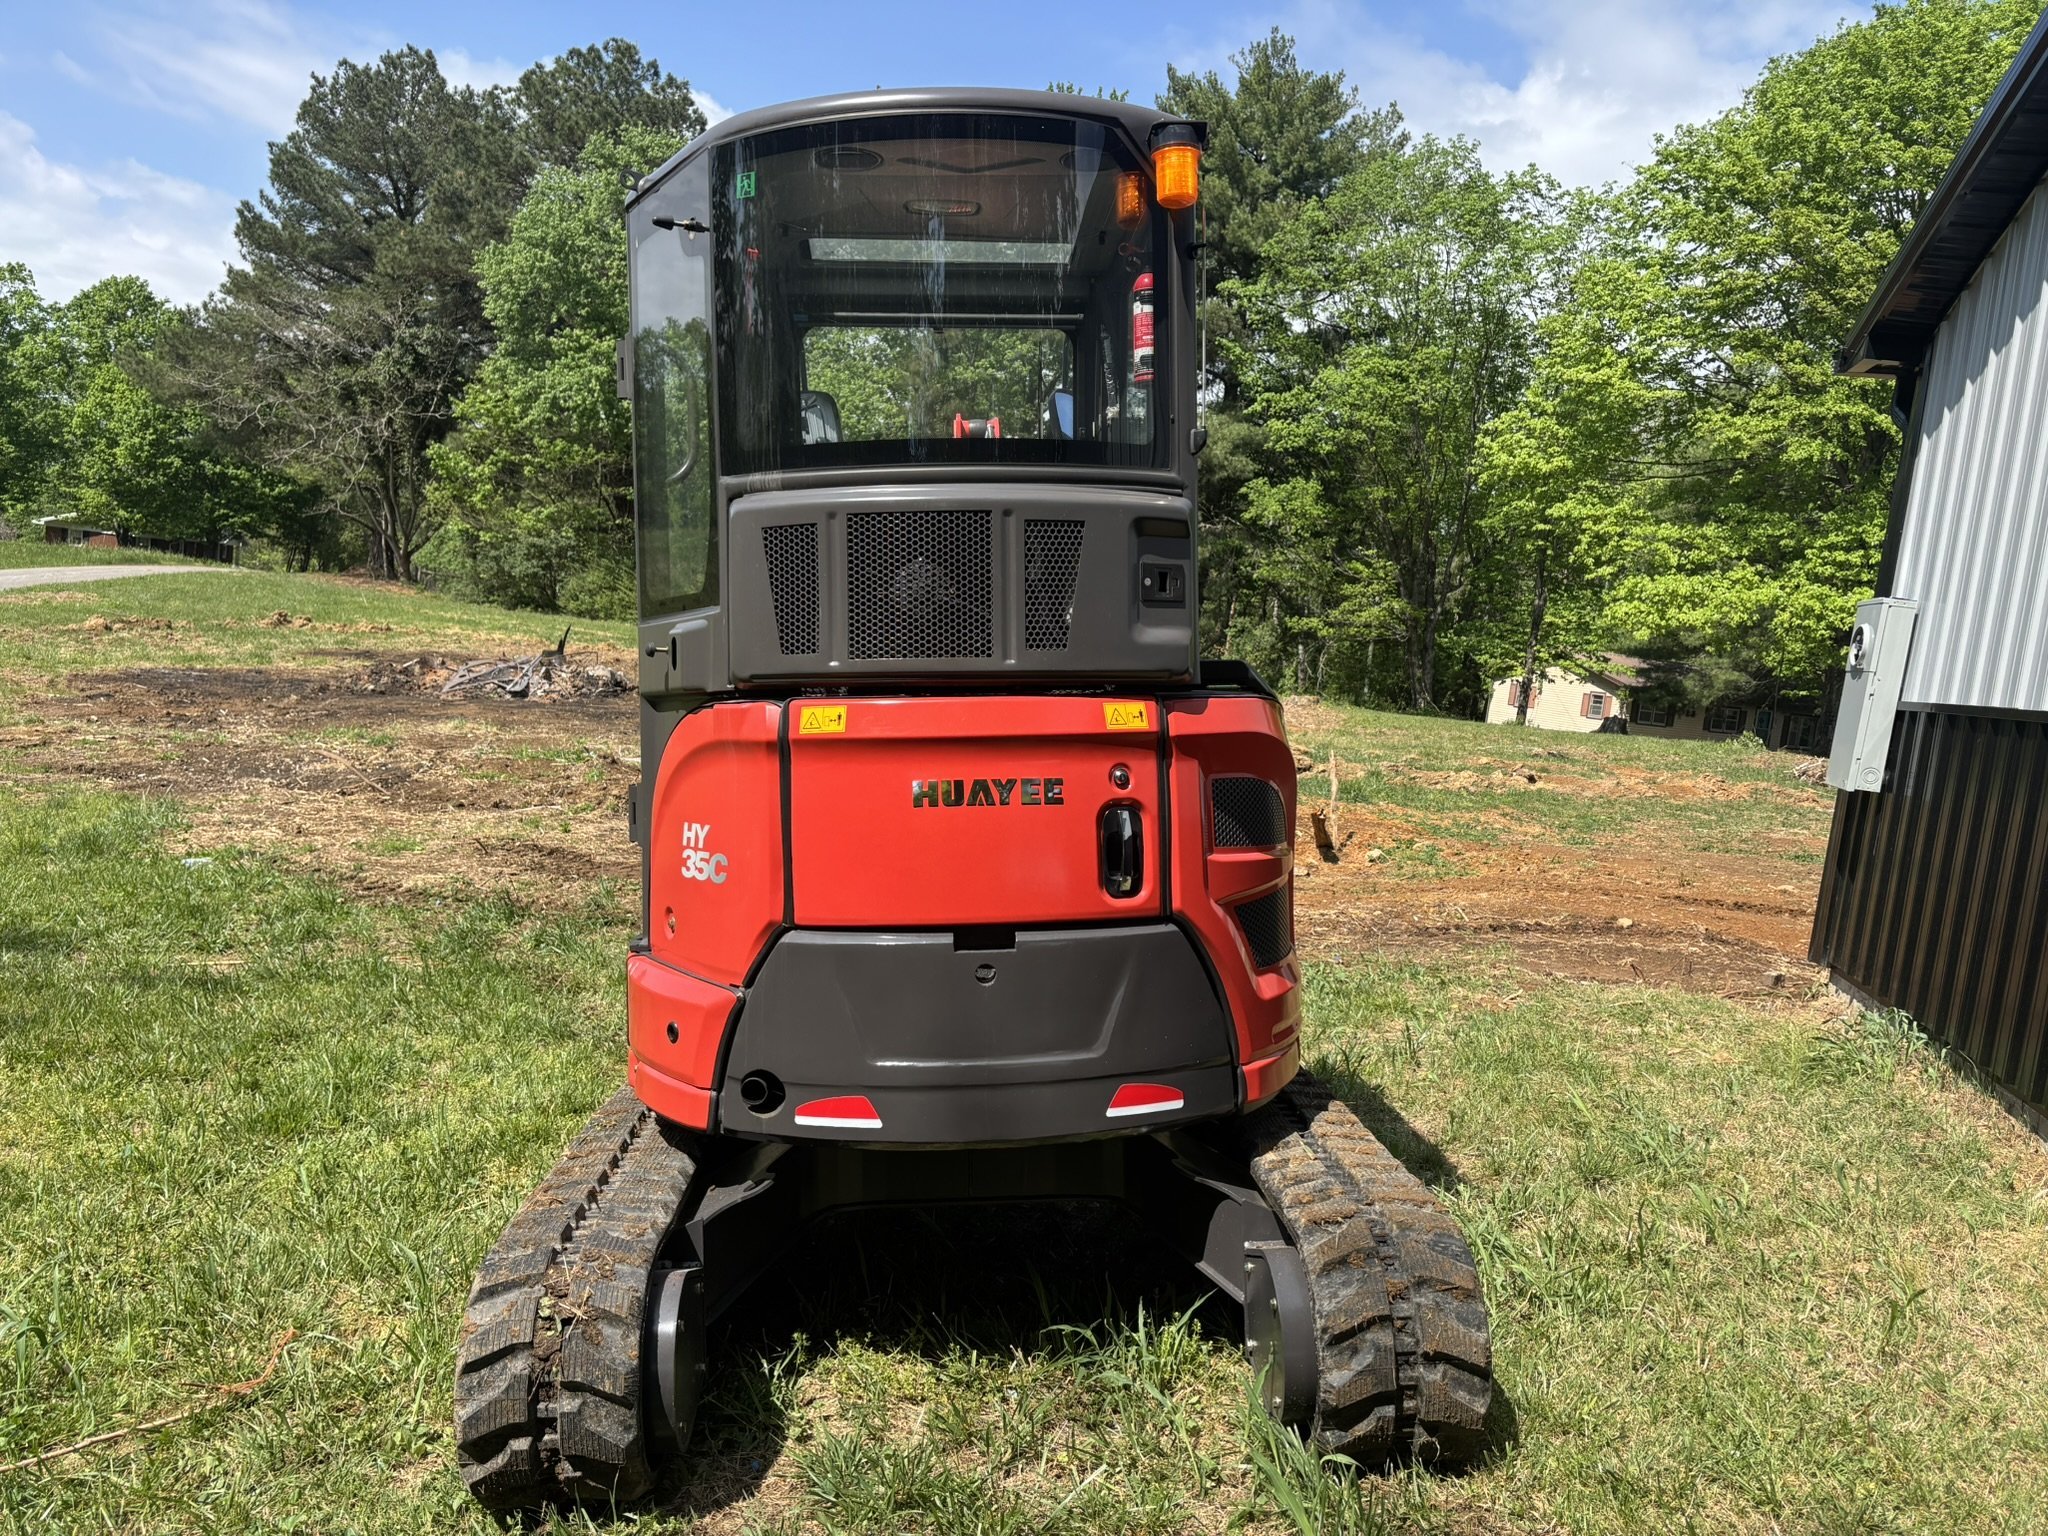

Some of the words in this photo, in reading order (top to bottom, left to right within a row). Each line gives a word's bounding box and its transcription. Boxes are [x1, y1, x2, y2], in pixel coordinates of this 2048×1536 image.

[912, 778, 1064, 808] HUAYEE
[682, 821, 711, 849] HY
[681, 848, 729, 885] 35C
